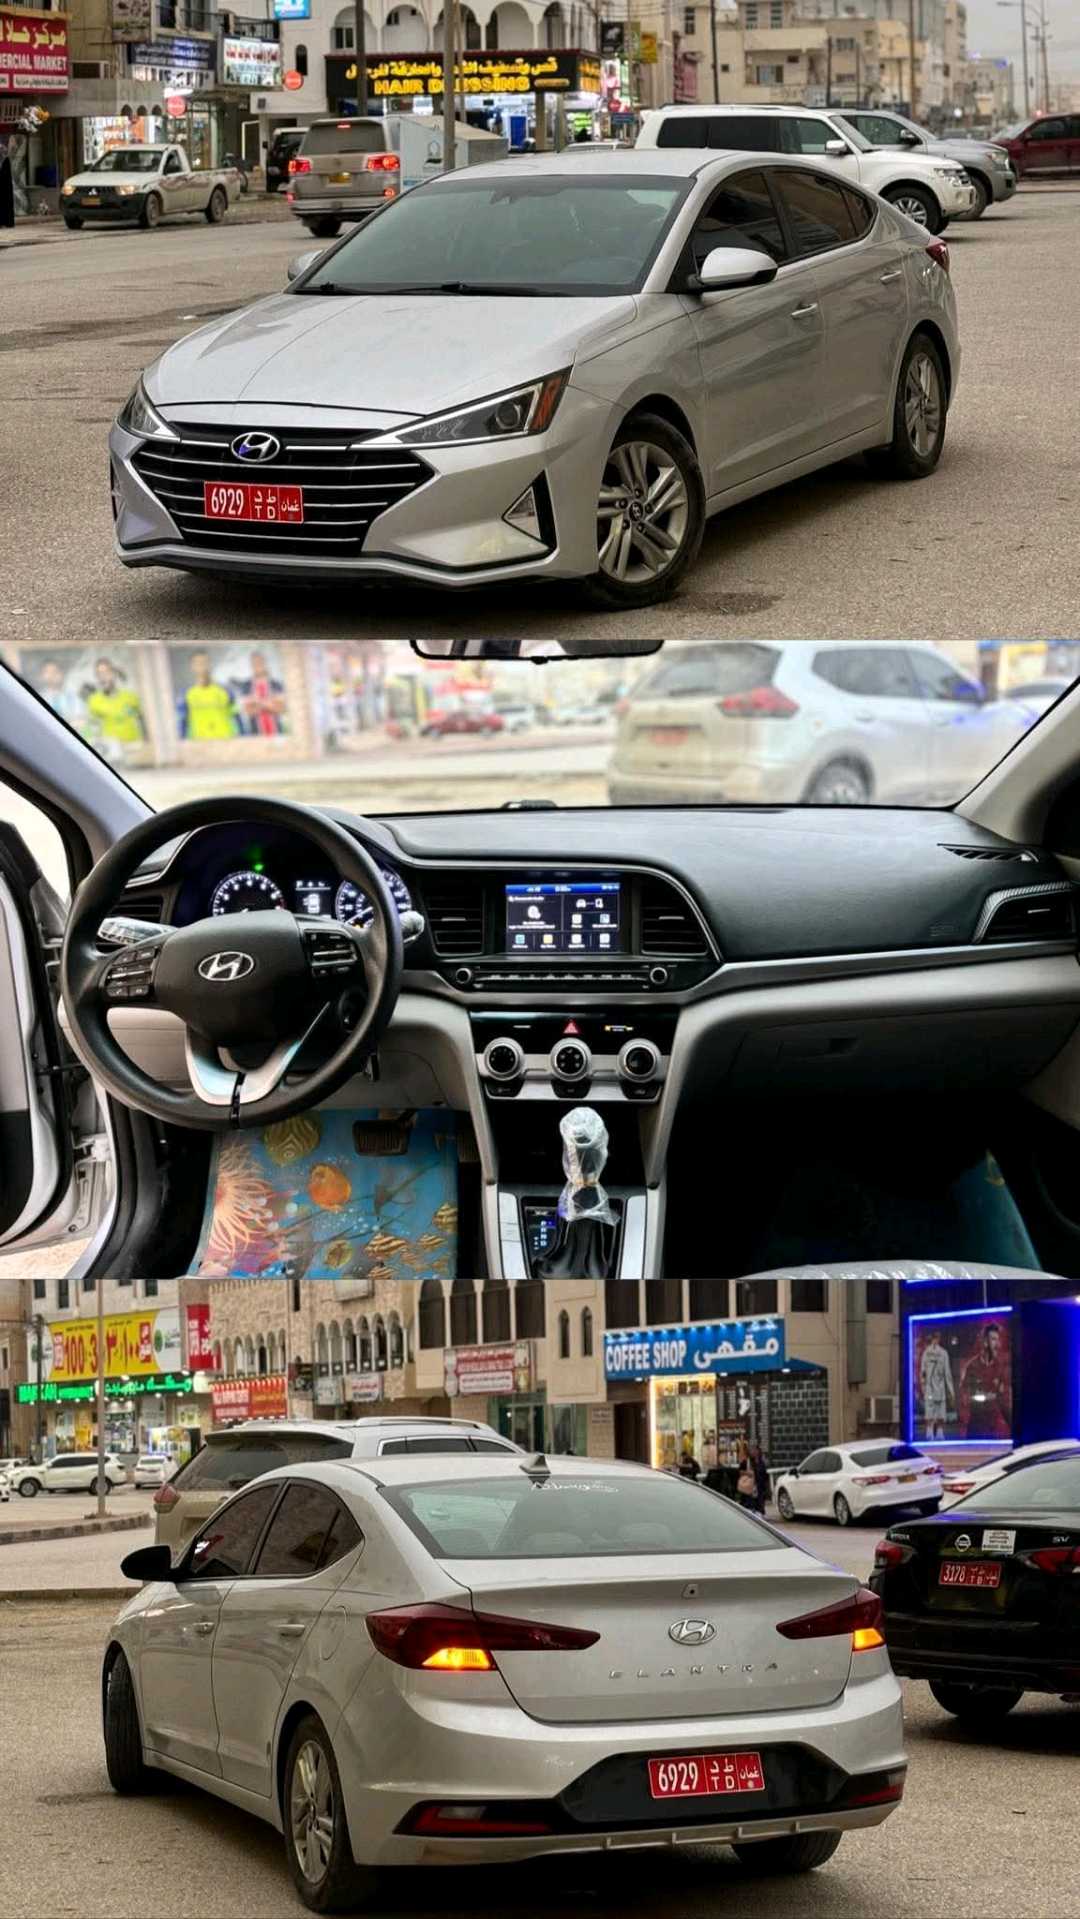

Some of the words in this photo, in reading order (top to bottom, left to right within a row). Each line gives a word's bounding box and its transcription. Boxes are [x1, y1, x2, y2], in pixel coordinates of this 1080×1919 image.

[32, 22, 66, 50] مركز
[33, 56, 67, 70] MARKET
[345, 62, 389, 79] للرل
[531, 56, 558, 75] قص
[374, 79, 425, 95] HAIR
[428, 75, 531, 94] DESSING
[211, 487, 244, 516] 6929
[254, 505, 263, 519] T
[266, 505, 276, 520] D
[65, 1335, 85, 1376] 100
[605, 1342, 650, 1371] COFFEE
[653, 1340, 687, 1368] SHOP
[1052, 1535, 1071, 1544] SV
[609, 1661, 778, 1680] ELANTRA
[723, 1757, 735, 1773] ط
[658, 1761, 699, 1792] 6929
[710, 1776, 720, 1790] T
[724, 1775, 735, 1790] D
